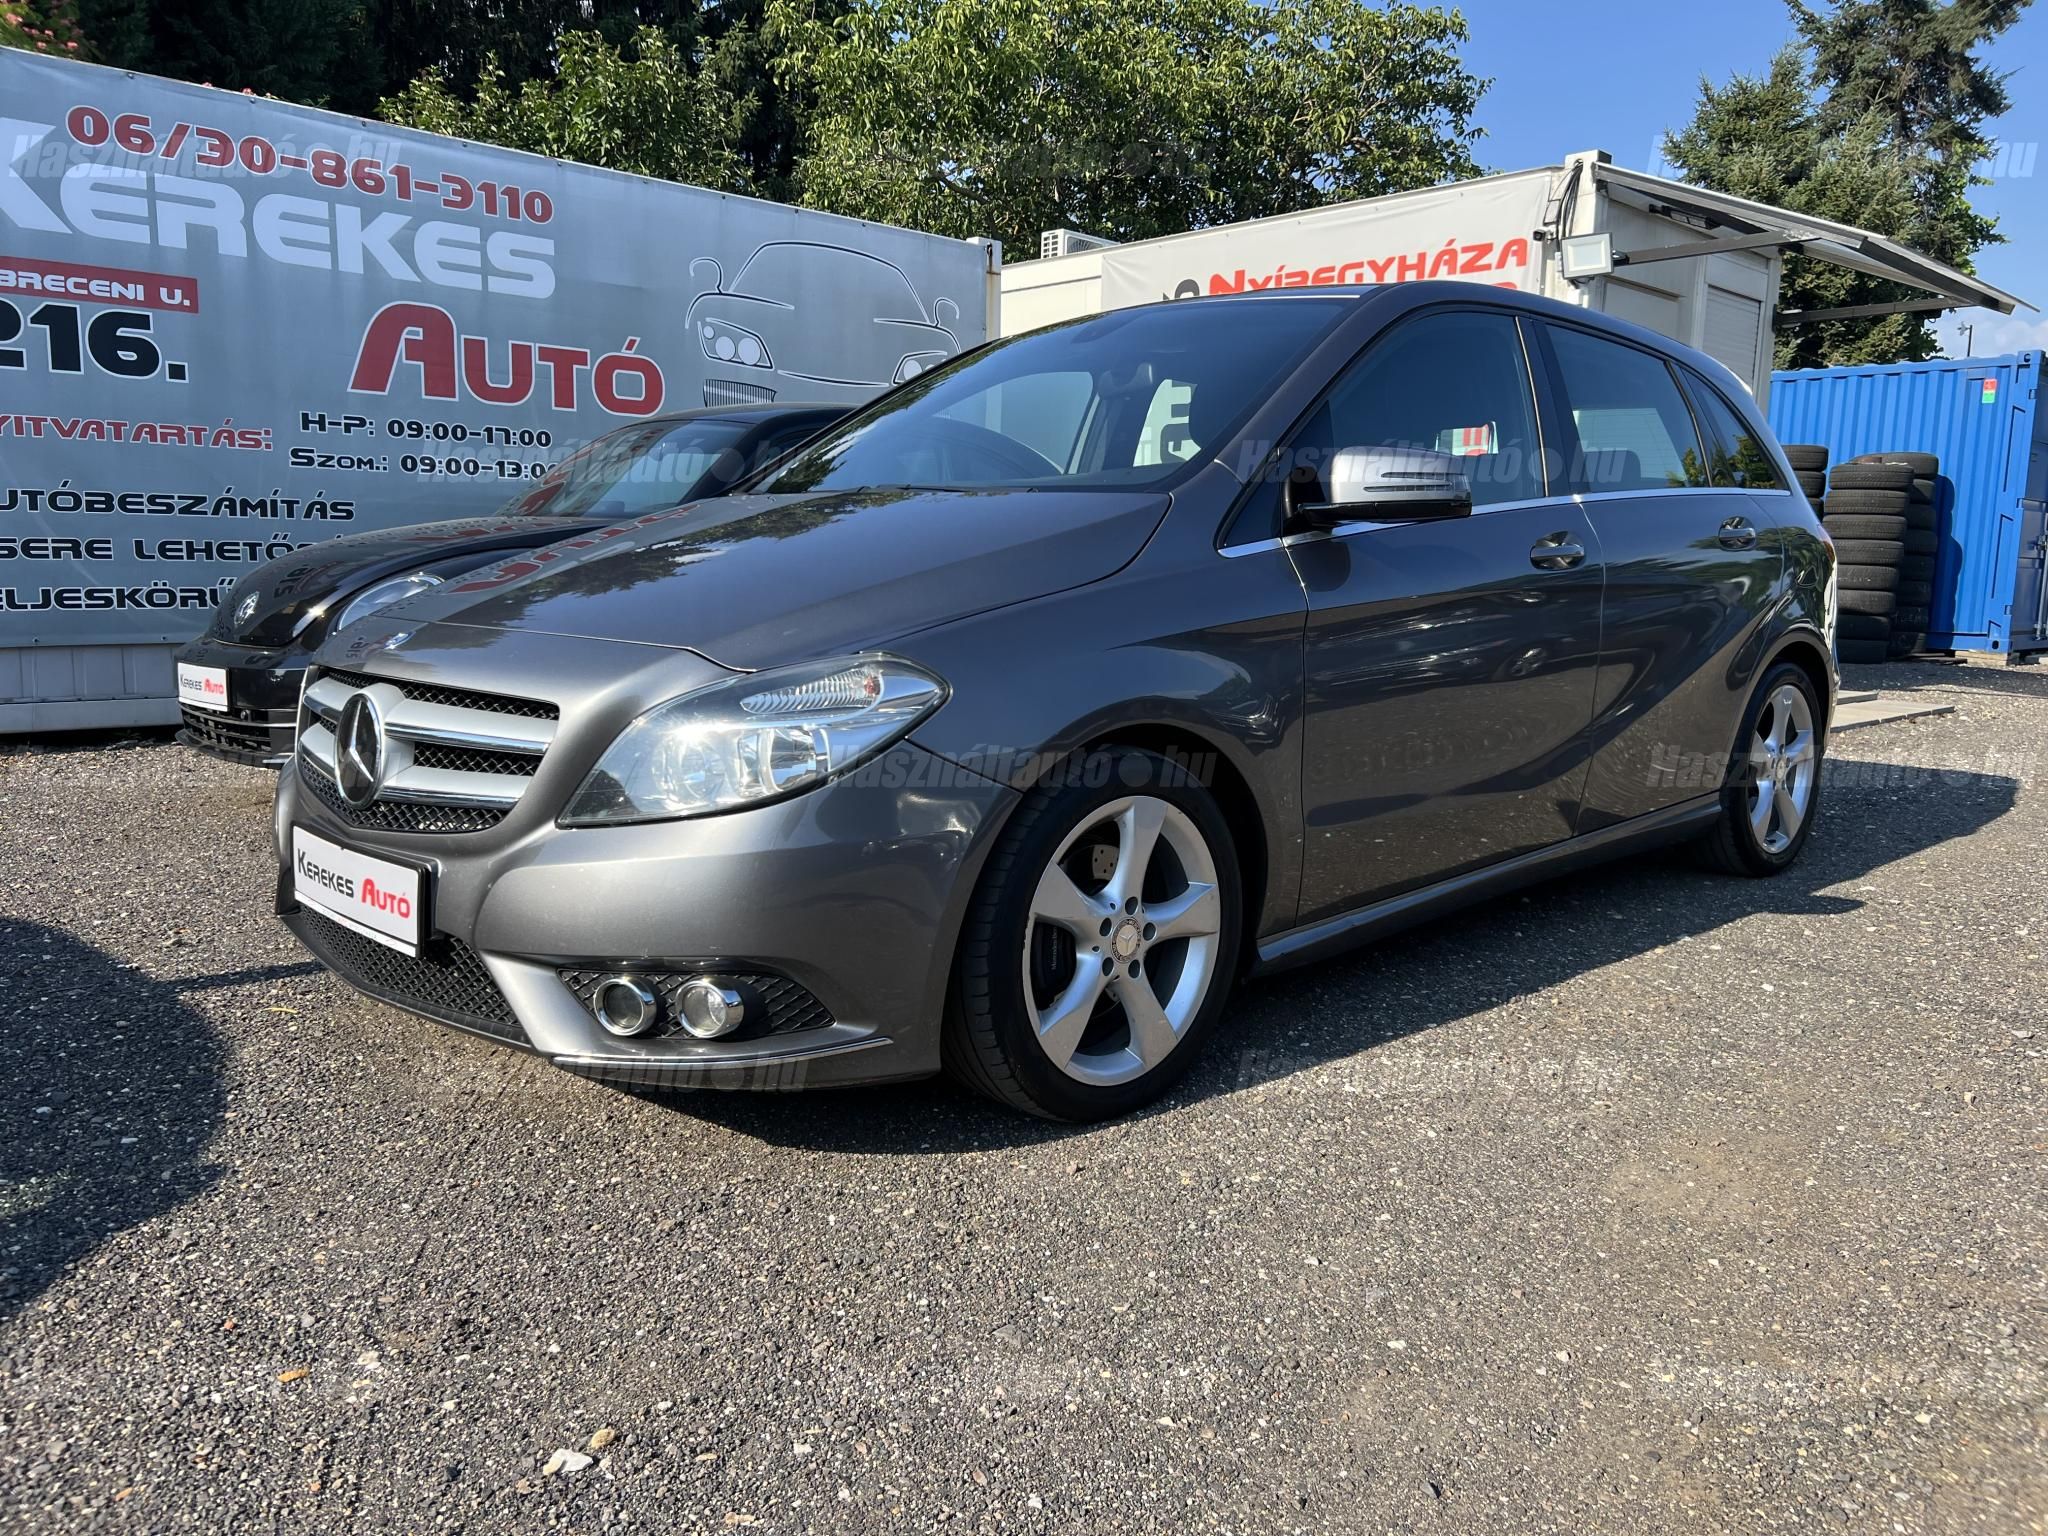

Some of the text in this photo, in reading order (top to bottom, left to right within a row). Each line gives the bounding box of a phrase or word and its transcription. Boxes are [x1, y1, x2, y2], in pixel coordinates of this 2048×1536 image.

[66, 104, 554, 225] 06/30-861-3110
[0, 269, 191, 307] BRECENI U.
[347, 300, 665, 417] AUTÓ
[300, 411, 552, 448] H-P: 09:00-17:00
[400, 454, 560, 480] 09:00-13:0
[298, 848, 354, 899] KEREKES
